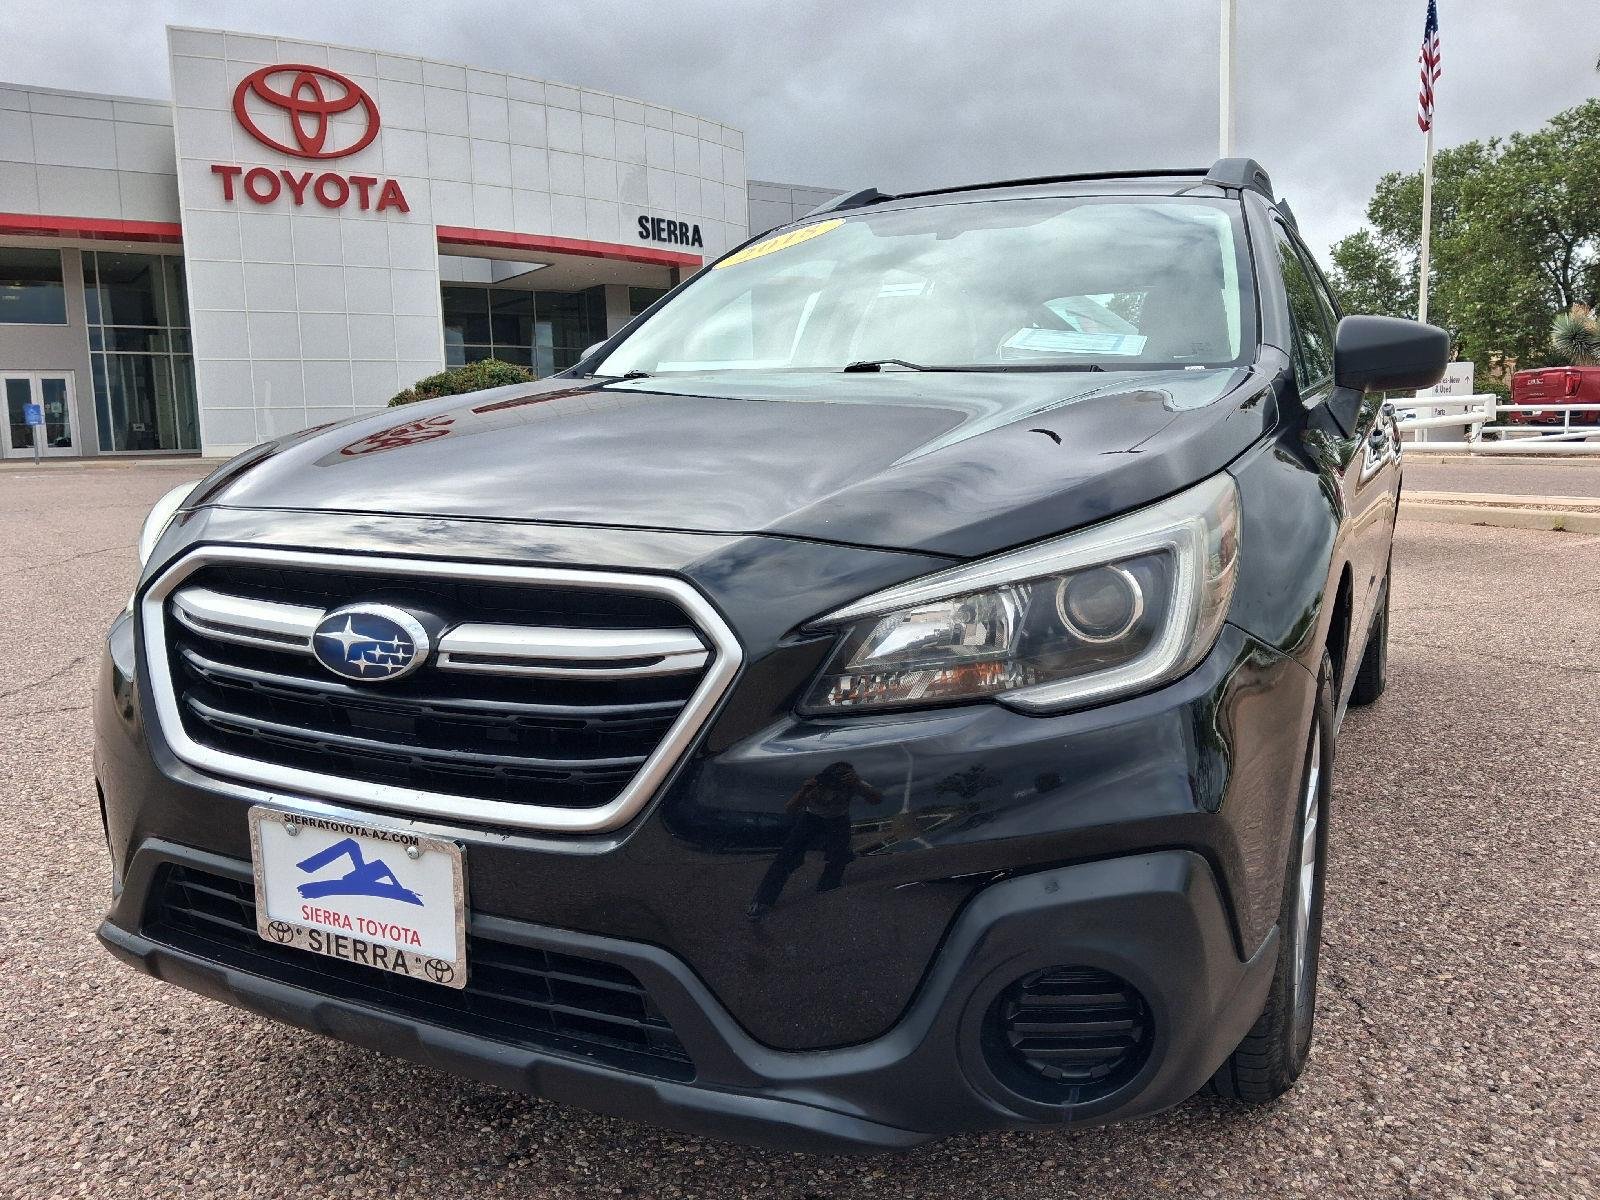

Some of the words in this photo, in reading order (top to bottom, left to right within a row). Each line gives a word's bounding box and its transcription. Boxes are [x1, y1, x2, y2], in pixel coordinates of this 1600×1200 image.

[211, 165, 410, 213] TOYOTA
[638, 215, 704, 247] SIERRA
[736, 224, 821, 260] 2018
[284, 813, 419, 846] SIERRATOYOTA-AZ.COM
[302, 904, 353, 931] SIERRA
[357, 917, 422, 947] TOYOTA
[308, 928, 410, 974] SIERRA
